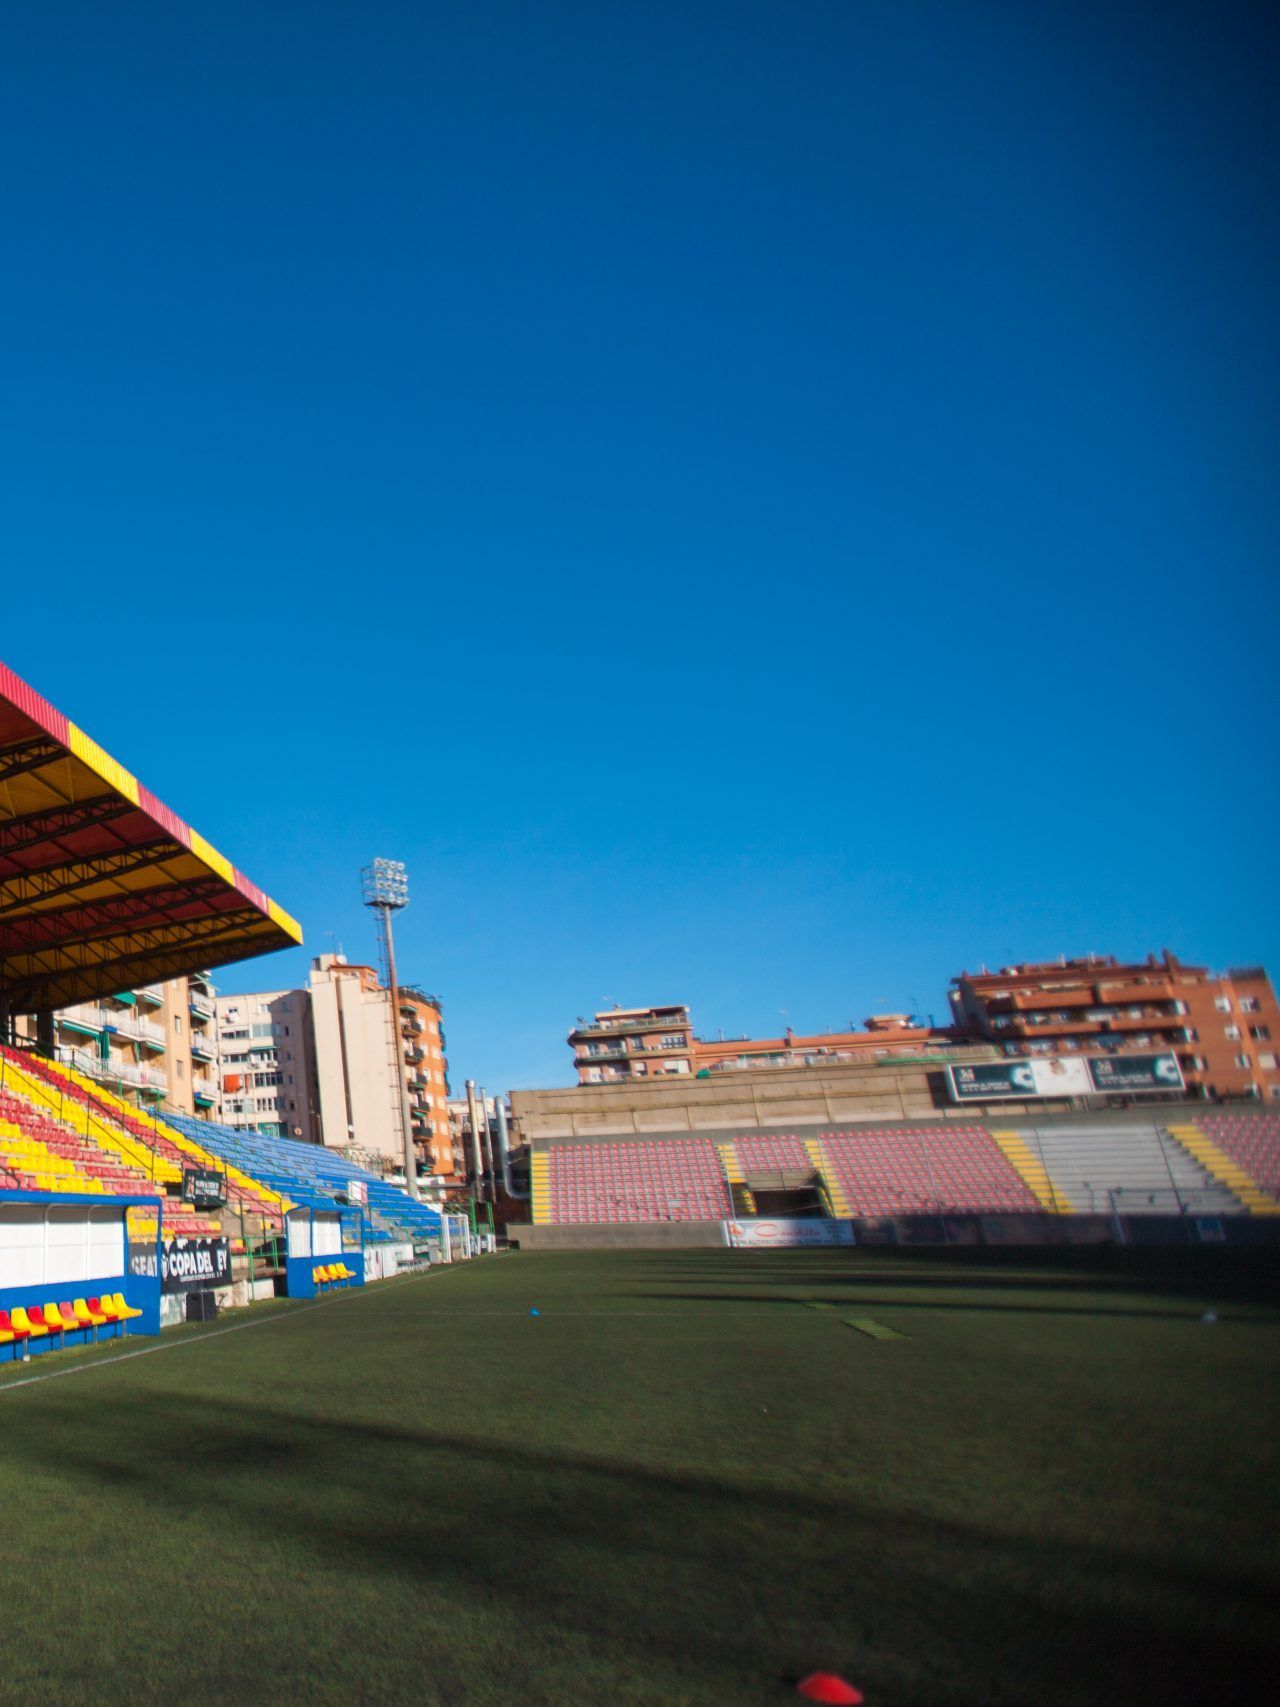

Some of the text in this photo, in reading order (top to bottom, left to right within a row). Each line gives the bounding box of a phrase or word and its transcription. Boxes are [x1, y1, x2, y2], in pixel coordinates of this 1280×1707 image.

[169, 1251, 196, 1277] COPA
[196, 1249, 214, 1272] DEL
[215, 1248, 227, 1271] EY
